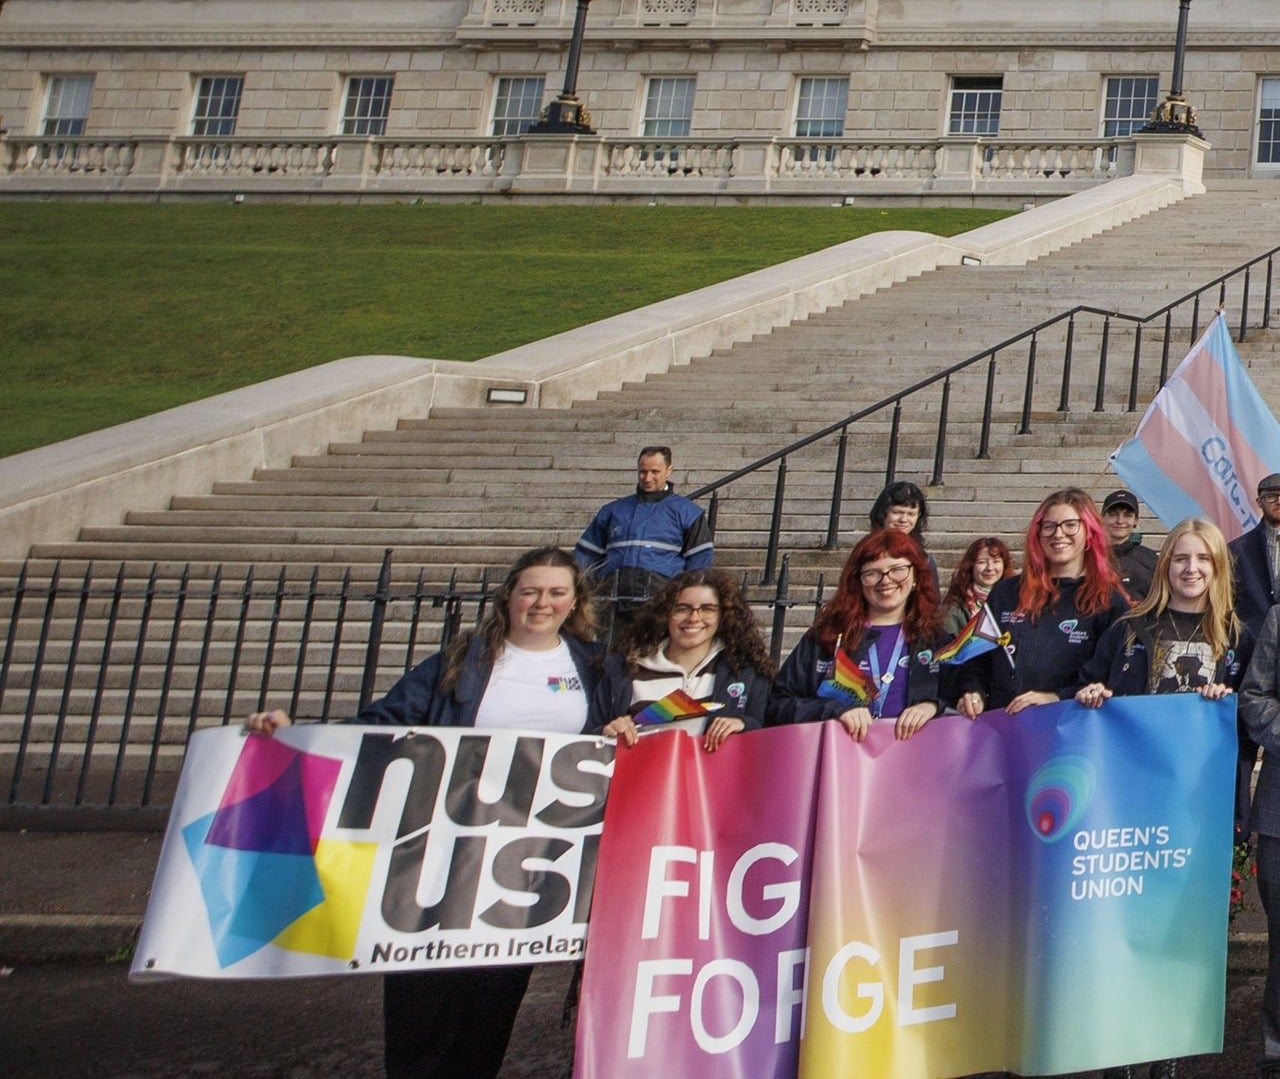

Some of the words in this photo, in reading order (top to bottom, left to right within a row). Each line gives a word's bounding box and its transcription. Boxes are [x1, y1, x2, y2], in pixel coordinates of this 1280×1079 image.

[337, 732, 616, 840] nus
[1073, 826, 1170, 851] QUEEN'S
[1072, 848, 1192, 876] STUDENTS'
[641, 842, 800, 936] FIG
[1071, 875, 1144, 901] UNION
[371, 940, 499, 963] Northern
[507, 935, 584, 956] Irelan
